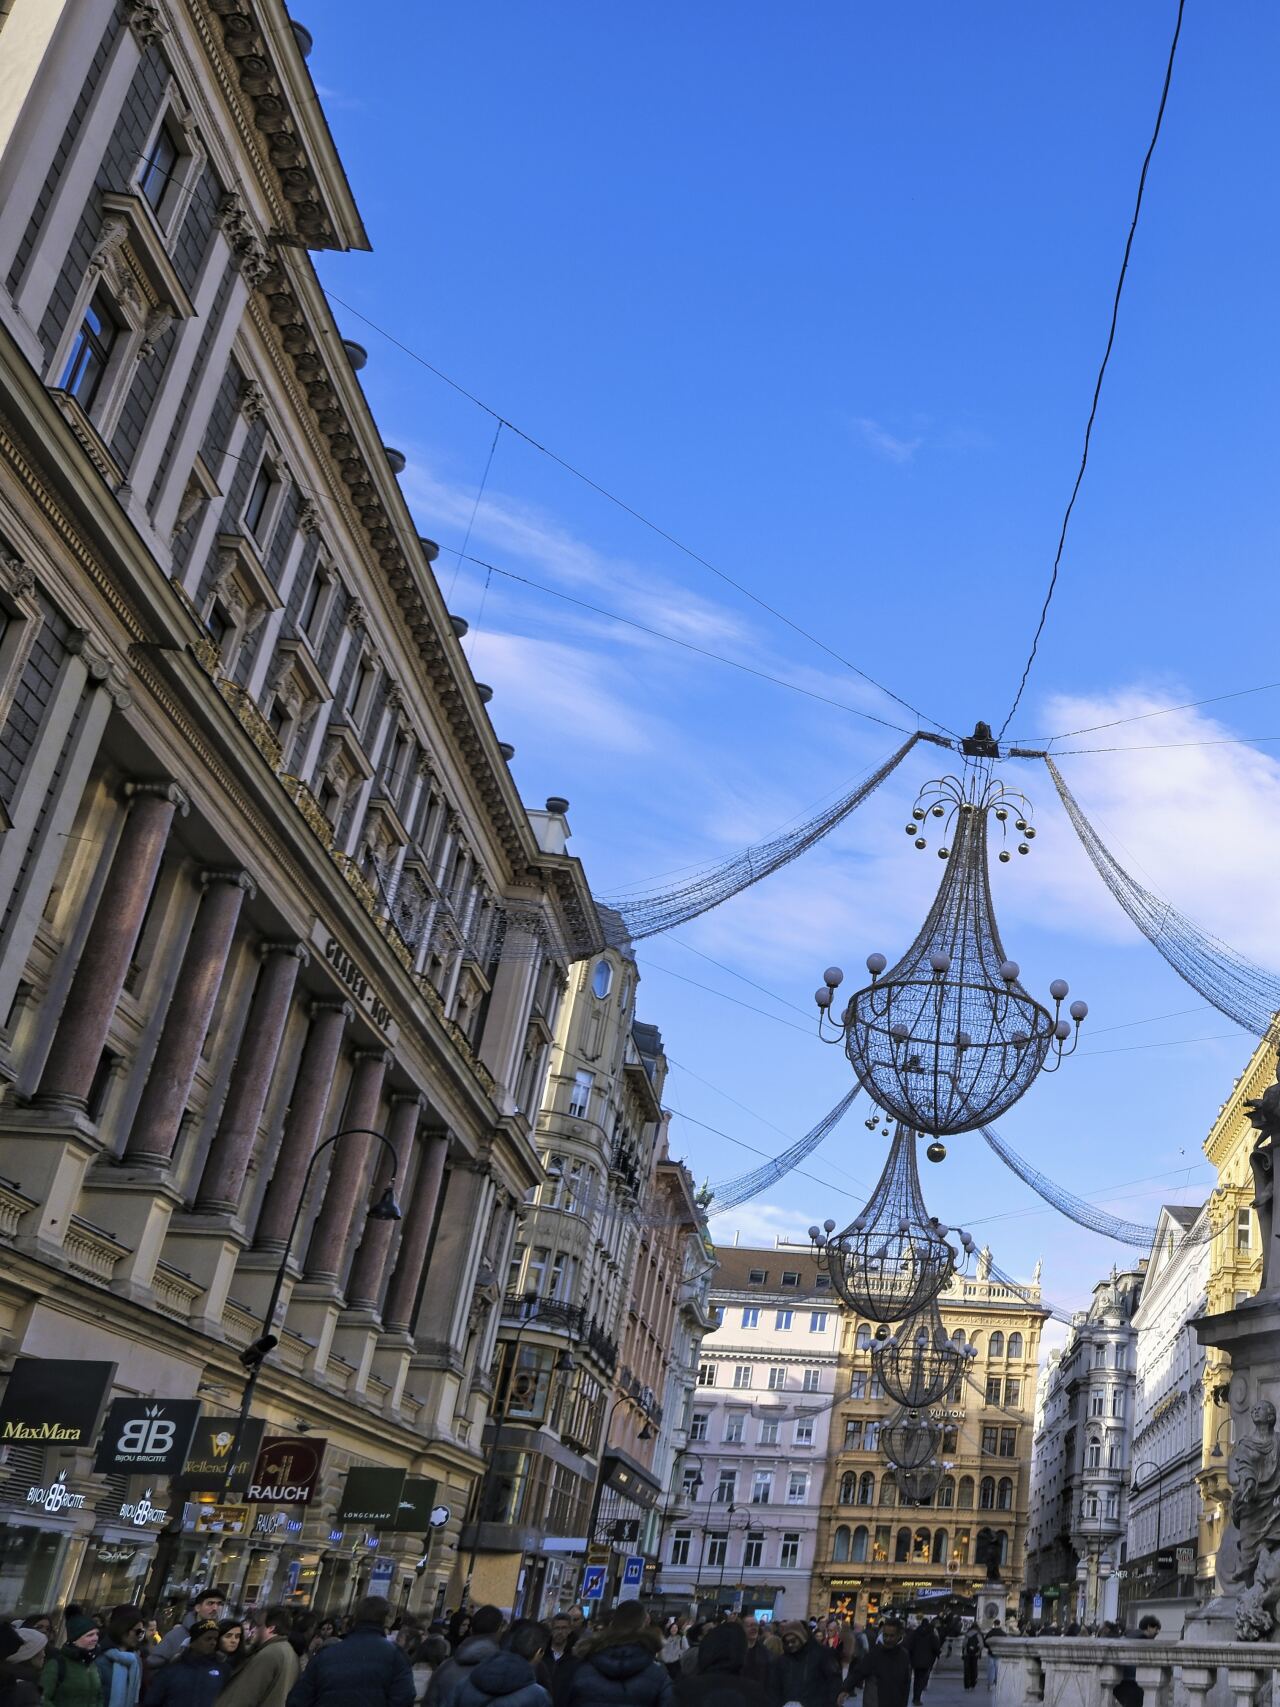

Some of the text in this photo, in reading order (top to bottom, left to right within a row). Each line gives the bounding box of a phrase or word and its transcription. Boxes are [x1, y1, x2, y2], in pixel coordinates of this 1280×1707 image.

[2, 1421, 81, 1440] MaxMara
[185, 1460, 249, 1473] Wellendrff
[247, 1485, 309, 1500] RAUCH
[256, 1513, 279, 1533] RAUCH
